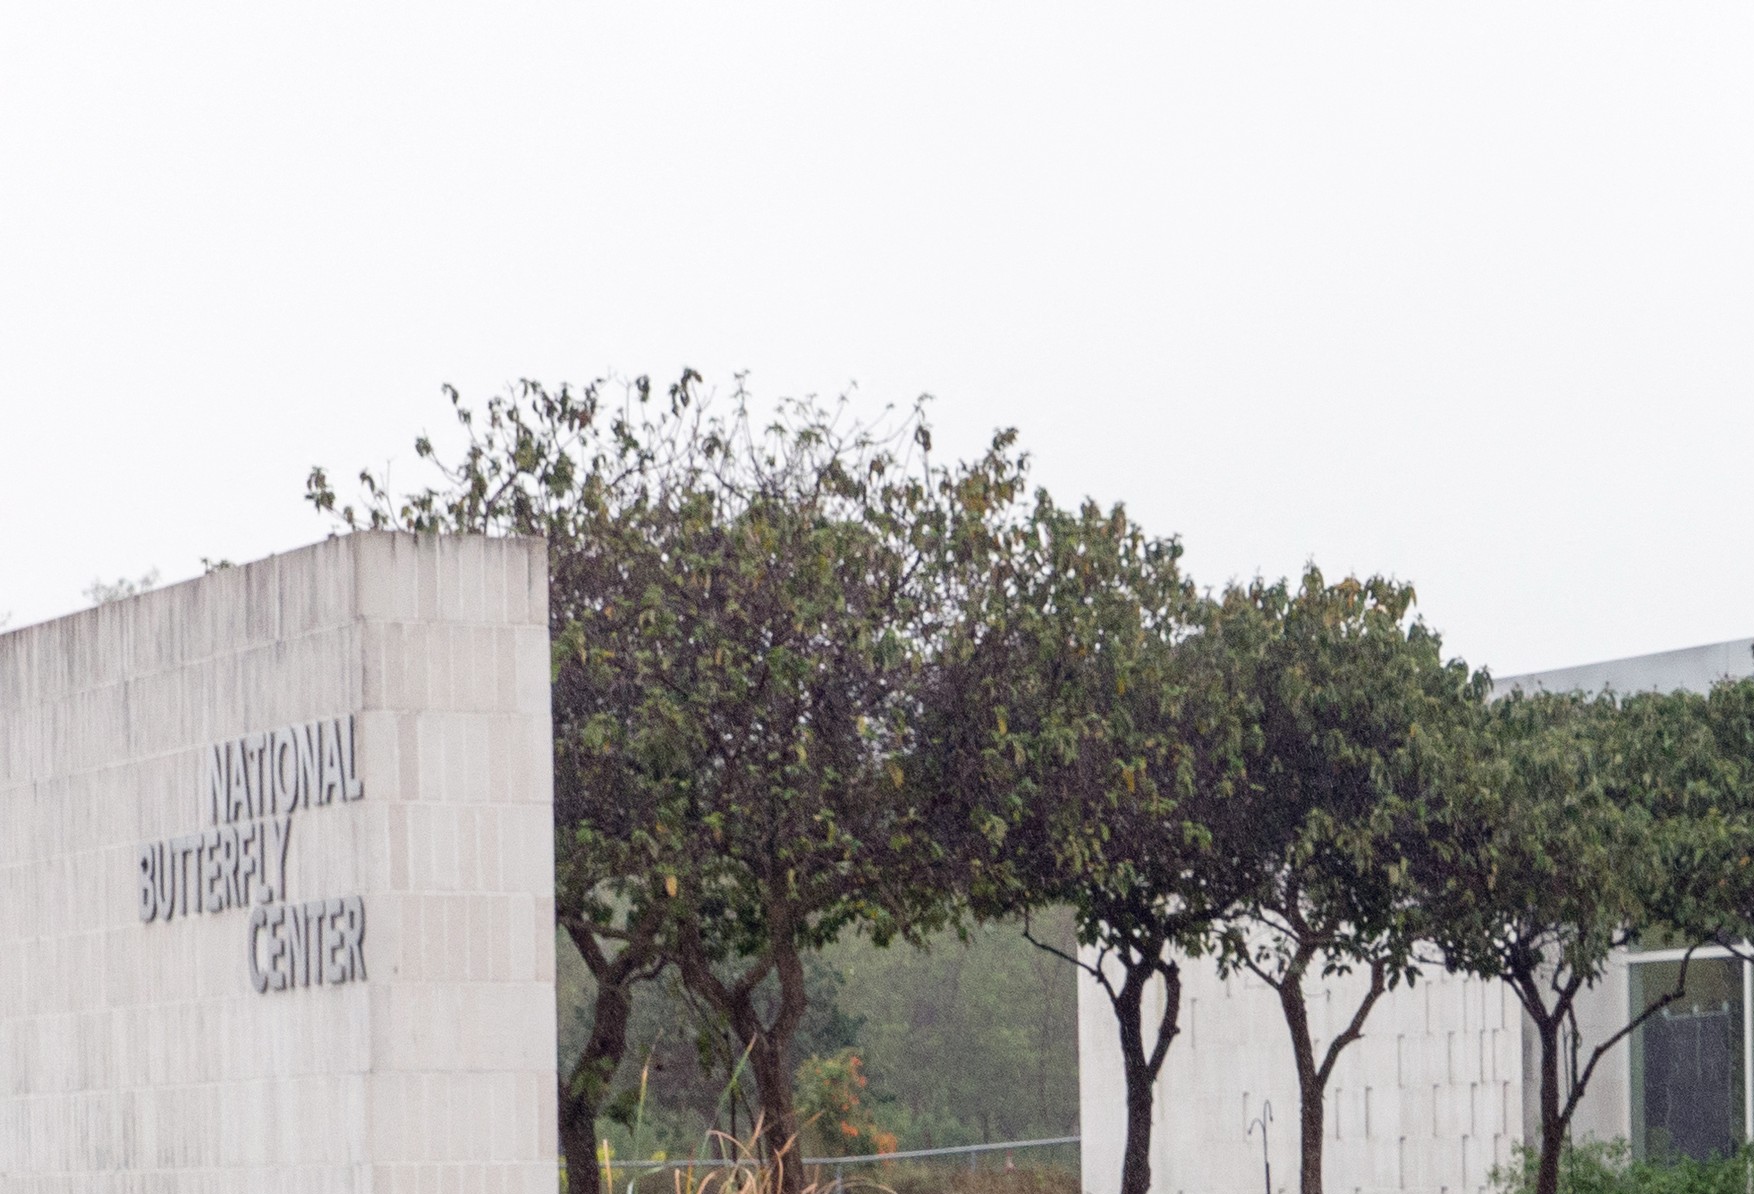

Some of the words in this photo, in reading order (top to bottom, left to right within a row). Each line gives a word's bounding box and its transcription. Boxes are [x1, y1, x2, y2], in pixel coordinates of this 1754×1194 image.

[208, 714, 364, 826] NATIONAL
[138, 816, 292, 924] BUTTERFLY
[250, 894, 368, 994] CENTER
